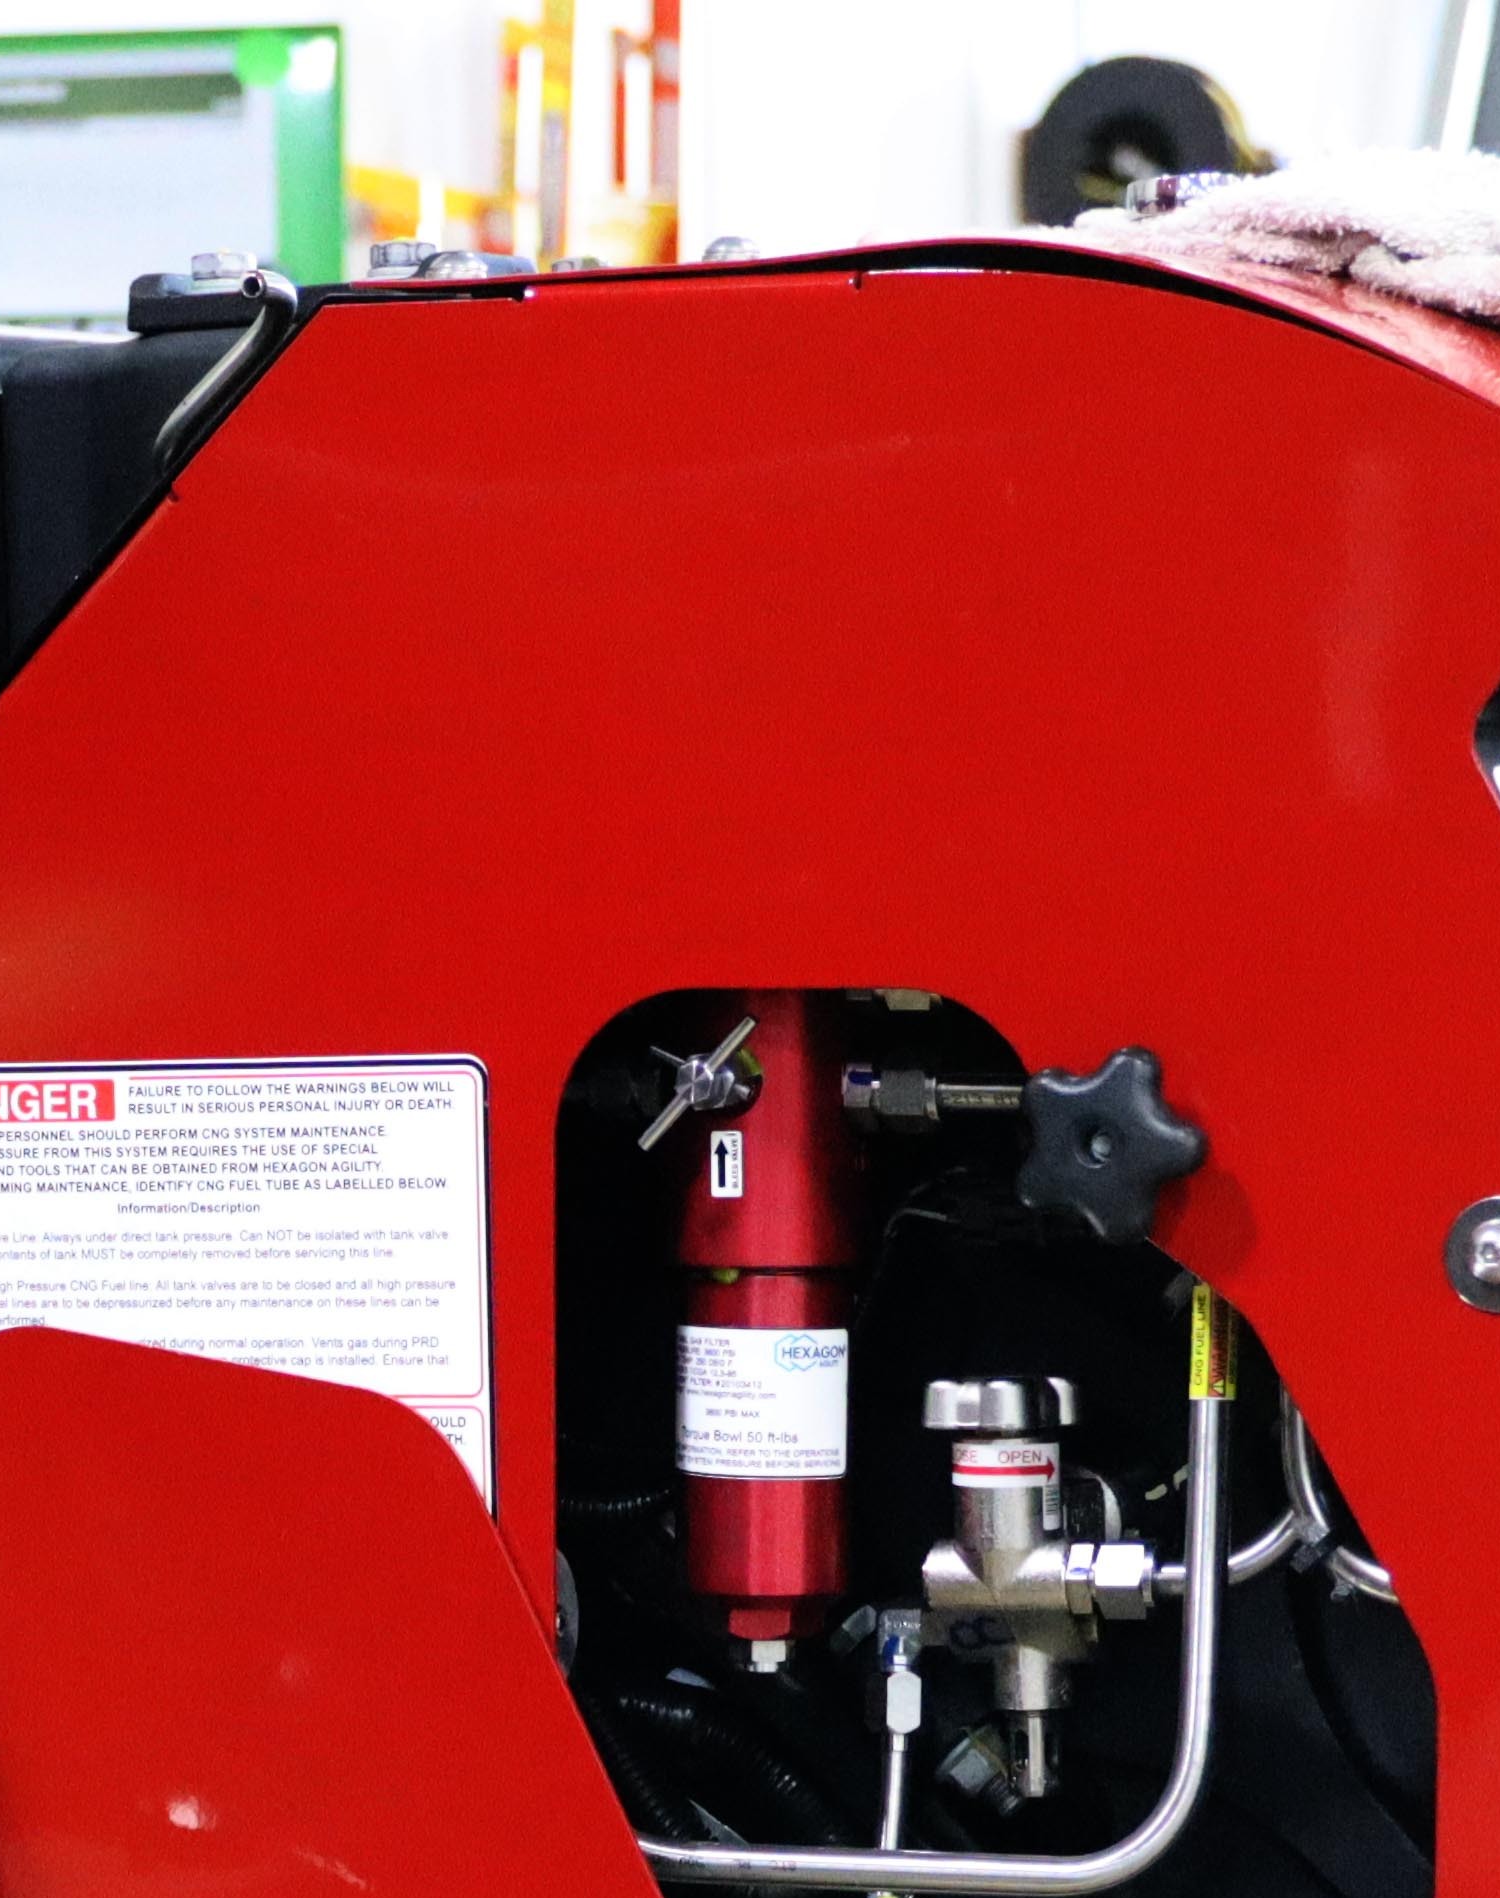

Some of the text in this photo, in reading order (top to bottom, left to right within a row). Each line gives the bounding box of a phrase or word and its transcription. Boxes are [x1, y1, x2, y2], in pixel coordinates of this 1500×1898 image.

[128, 1081, 454, 1097] FAILURE TO FOLLOW THE WARNINGS BELOW WILL
[128, 1100, 403, 1114] RESULT IN SERIOUS PERSONAL INJURY OR
[0, 1130, 73, 1142] PERSONNEL
[78, 1129, 131, 1141] SHOULD
[135, 1128, 197, 1140] PERFORM
[202, 1128, 229, 1139] CNG
[234, 1127, 286, 1139] SYSTEM
[44, 1147, 79, 1159] FROM
[85, 1147, 112, 1158] THIS
[116, 1146, 167, 1158] SYSTEM
[172, 1145, 237, 1157] REQUIRES
[242, 1145, 266, 1156] THE
[271, 1145, 296, 1156] USE
[301, 1144, 318, 1155] OF
[323, 1143, 378, 1155] SPECIAL
[19, 1164, 60, 1176] TOOLS
[65, 1164, 96, 1175] THAT
[101, 1164, 127, 1175] CAN
[131, 1164, 148, 1175] BE
[153, 1163, 217, 1175] OBTAINED
[222, 1162, 258, 1174] FROM
[263, 1161, 327, 1173] HEXAGON
[37, 1181, 131, 1194] MAINTENANCE,
[136, 1180, 193, 1192] IDENTIFY
[197, 1180, 225, 1191] CNG
[229, 1179, 261, 1191] FUEL
[267, 1179, 300, 1190] TUBE
[304, 1179, 320, 1190] AS
[326, 1178, 393, 1189] LABELLED
[118, 1202, 260, 1214] Information/Description
[297, 1229, 414, 1241] be isolated with tank
[40, 1249, 51, 1260] of
[54, 1249, 76, 1260] tank
[81, 1249, 115, 1260] MUST
[120, 1248, 133, 1259] be
[137, 1247, 197, 1261] completely
[201, 1247, 251, 1259] removed
[255, 1247, 291, 1258] before
[295, 1247, 345, 1260] servicing
[350, 1247, 369, 1257] this
[17, 1280, 66, 1291] Pressure
[71, 1280, 98, 1291] CNG
[102, 1280, 125, 1291] Fuel
[155, 1279, 168, 1291] All
[173, 1279, 196, 1290] tank
[200, 1279, 236, 1290] valves
[240, 1281, 259, 1290] are
[263, 1279, 272, 1290] to
[277, 1279, 290, 1290] be
[295, 1279, 331, 1290] closed
[335, 1279, 356, 1289] and
[361, 1279, 372, 1289] all
[377, 1278, 401, 1291] high
[405, 1279, 455, 1291] pressure
[12, 1297, 38, 1308] lines
[42, 1299, 58, 1308] are
[62, 1298, 72, 1308] to
[76, 1297, 90, 1308] be
[95, 1297, 172, 1310] depressurized
[176, 1297, 211, 1308] before
[216, 1299, 235, 1310] any
[240, 1297, 313, 1307] maintenance
[317, 1299, 331, 1307] on
[335, 1296, 366, 1307] these
[371, 1296, 396, 1307] lines
[401, 1298, 421, 1307] can
[425, 1296, 440, 1307] be
[704, 1338, 730, 1346] FILTER
[1195, 1295, 1207, 1386] CNG FUEL LINE
[782, 1345, 846, 1358] HEXAGON
[741, 1410, 760, 1418] MAX
[714, 1430, 742, 1442] Bowl
[748, 1432, 762, 1442] 50
[768, 1432, 798, 1444] ft-lbs
[760, 1449, 770, 1457] TO
[774, 1449, 790, 1457] THE
[998, 1450, 1042, 1464] OPEN
[716, 1457, 800, 1468] PRESSURE BEFORE
